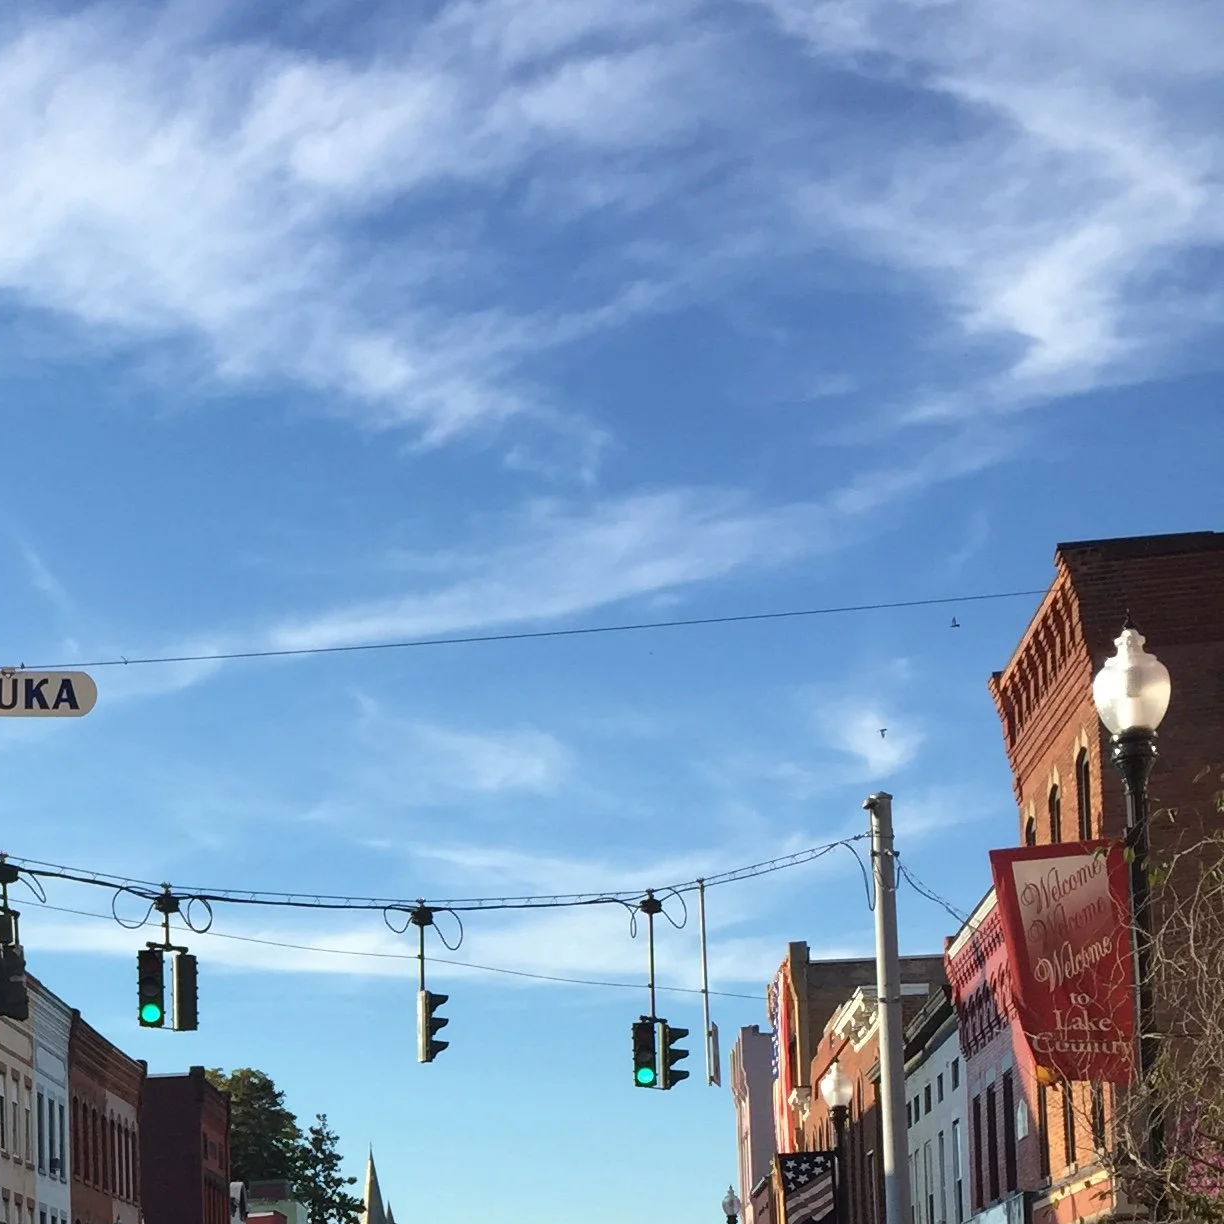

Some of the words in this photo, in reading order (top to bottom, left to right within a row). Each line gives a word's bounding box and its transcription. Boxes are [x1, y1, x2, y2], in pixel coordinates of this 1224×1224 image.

[1021, 860, 1102, 914] Welcome
[1029, 895, 1107, 946] Welcome
[1034, 935, 1114, 992] Welcome
[1069, 992, 1090, 1005] to
[1052, 1009, 1113, 1032] Lake
[1032, 1032, 1132, 1060] Country
